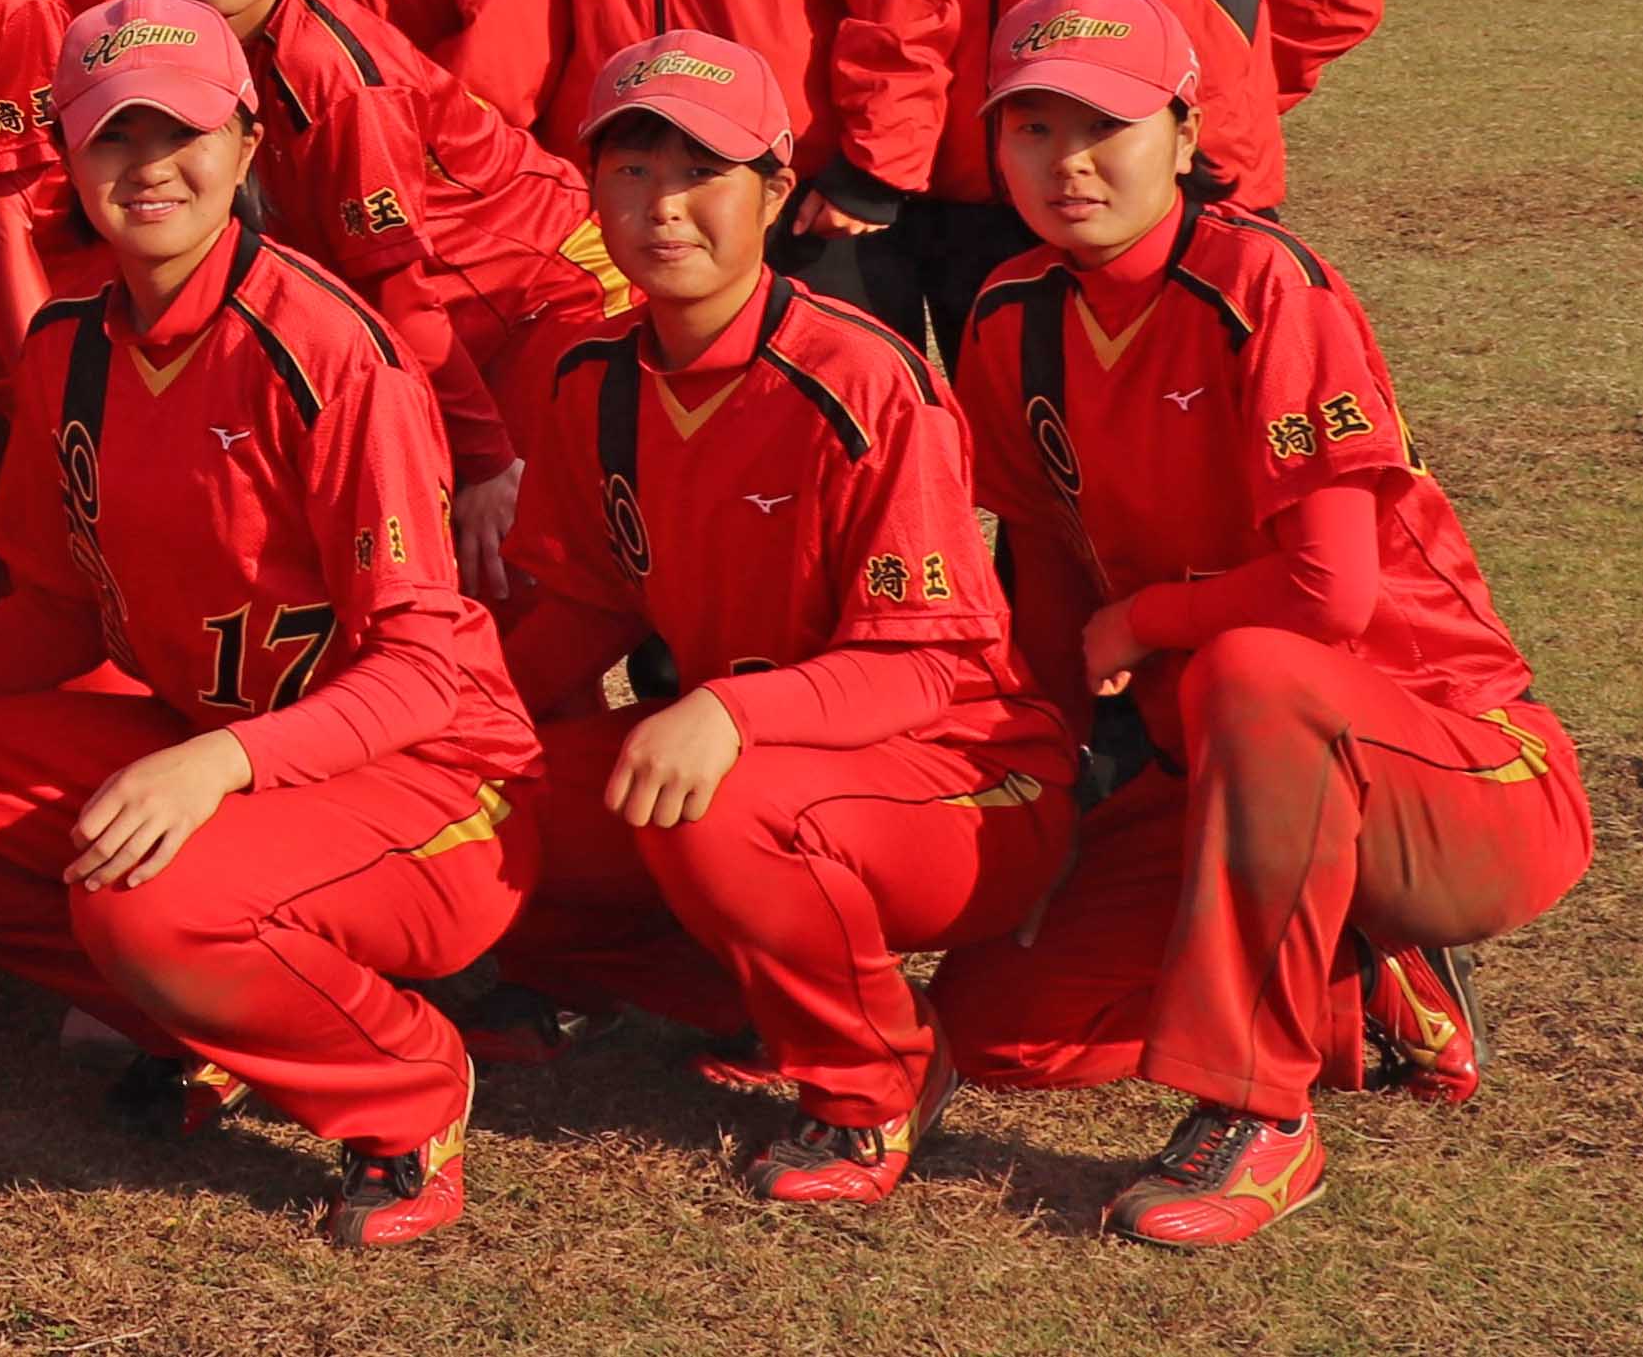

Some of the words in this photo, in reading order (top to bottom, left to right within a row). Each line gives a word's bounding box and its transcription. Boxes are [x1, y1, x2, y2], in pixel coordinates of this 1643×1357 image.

[82, 19, 200, 73] HOSHINO
[1010, 9, 1132, 59] HOSHINO
[617, 49, 736, 93] HOSHINO
[1267, 391, 1375, 461] 埼玉
[867, 551, 952, 602] 埼玉
[198, 601, 339, 713] 17
